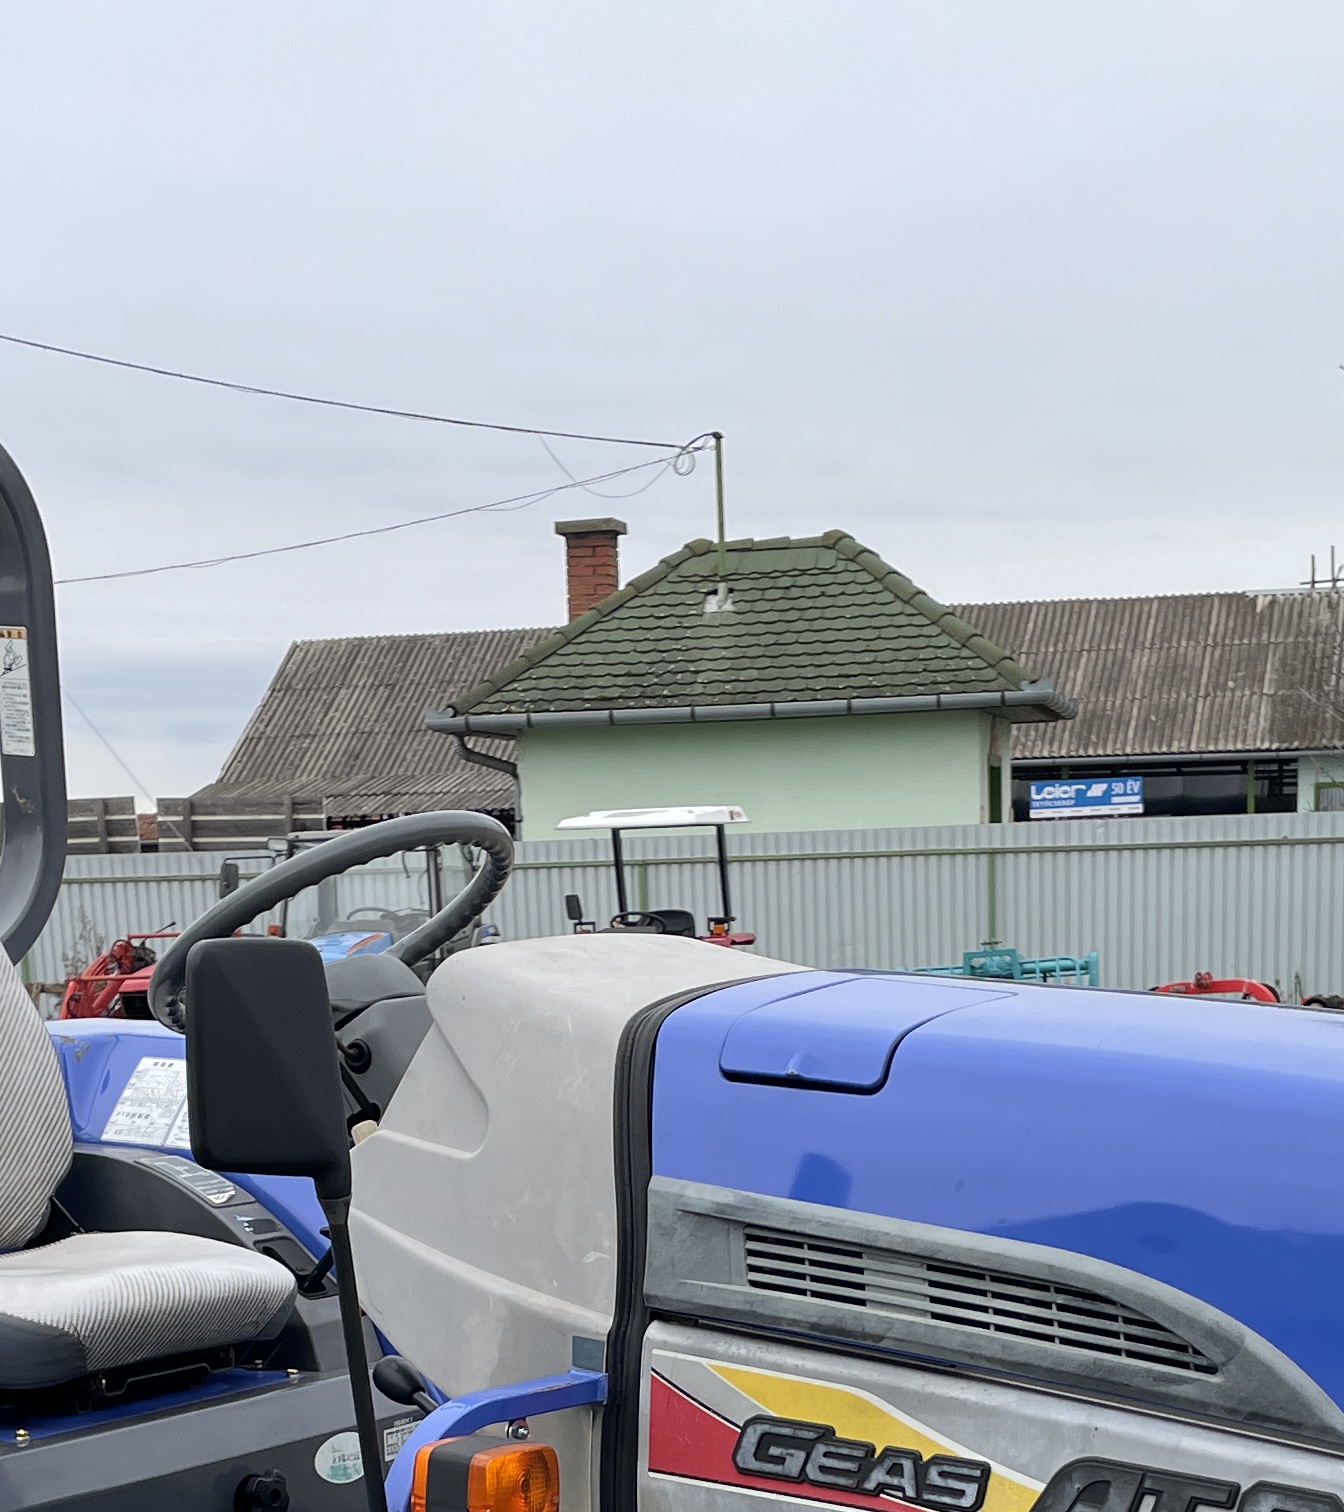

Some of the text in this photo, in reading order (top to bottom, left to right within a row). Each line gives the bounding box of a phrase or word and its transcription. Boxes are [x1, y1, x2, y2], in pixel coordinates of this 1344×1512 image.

[1030, 779, 1141, 800] Leier 50 ÉV
